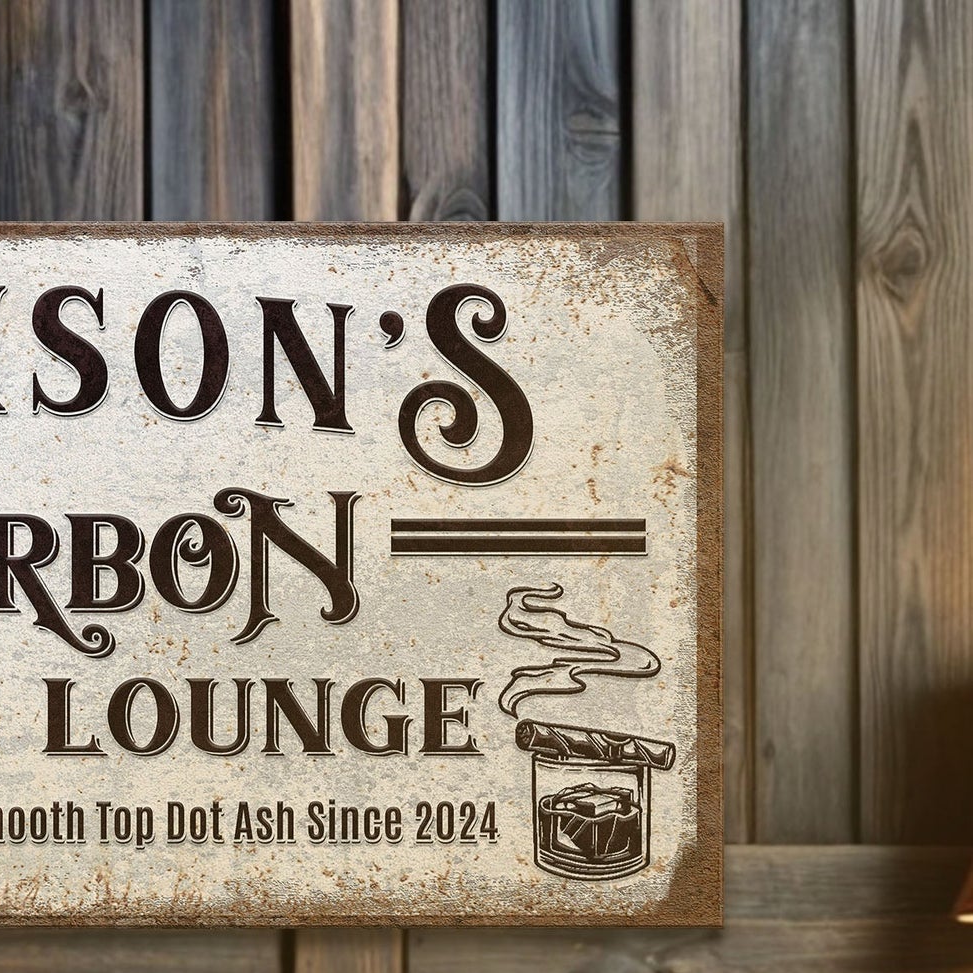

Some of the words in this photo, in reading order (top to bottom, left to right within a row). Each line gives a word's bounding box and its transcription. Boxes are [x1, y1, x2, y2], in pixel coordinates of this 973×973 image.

[42, 676, 484, 757] LOUNGE
[95, 801, 155, 848] Top
[167, 801, 224, 843] Dot
[233, 800, 296, 843] Ash
[307, 799, 403, 843] Since
[415, 800, 499, 843] 2024
